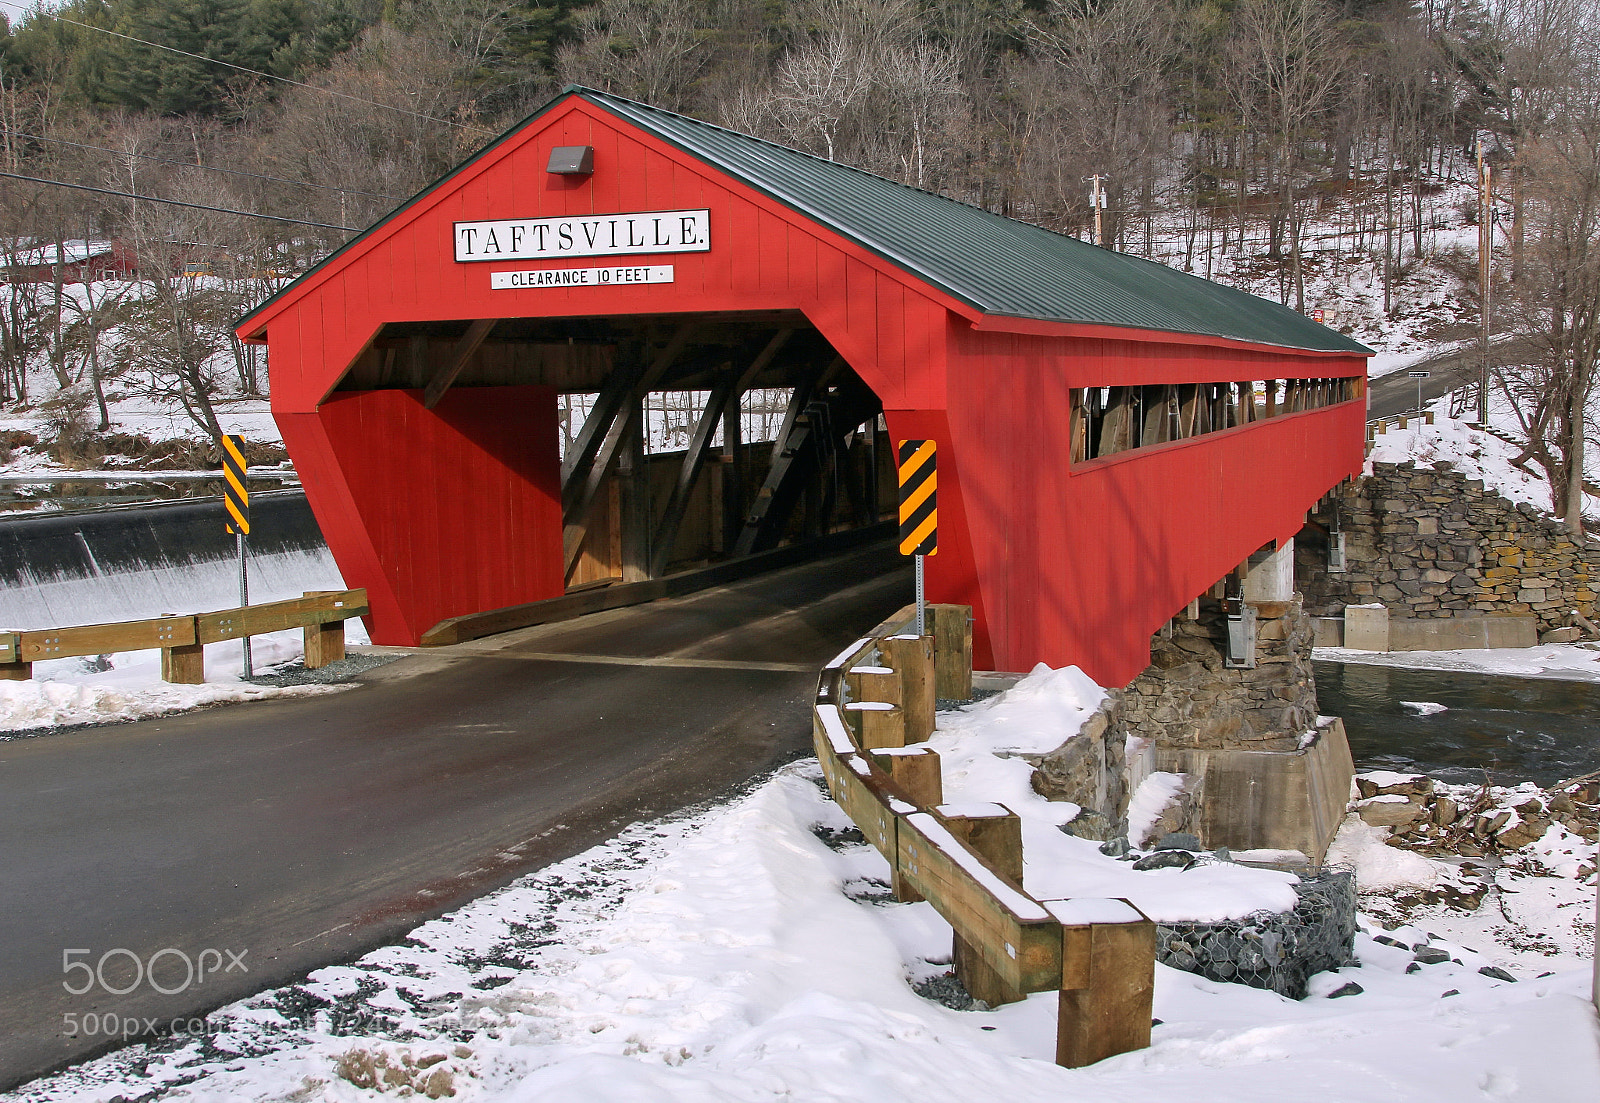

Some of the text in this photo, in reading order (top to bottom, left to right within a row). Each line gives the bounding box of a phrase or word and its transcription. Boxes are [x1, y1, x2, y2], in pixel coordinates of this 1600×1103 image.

[461, 216, 704, 255] TAFTSVILLE.
[511, 267, 651, 286] CLEARANCE 10 FEET
